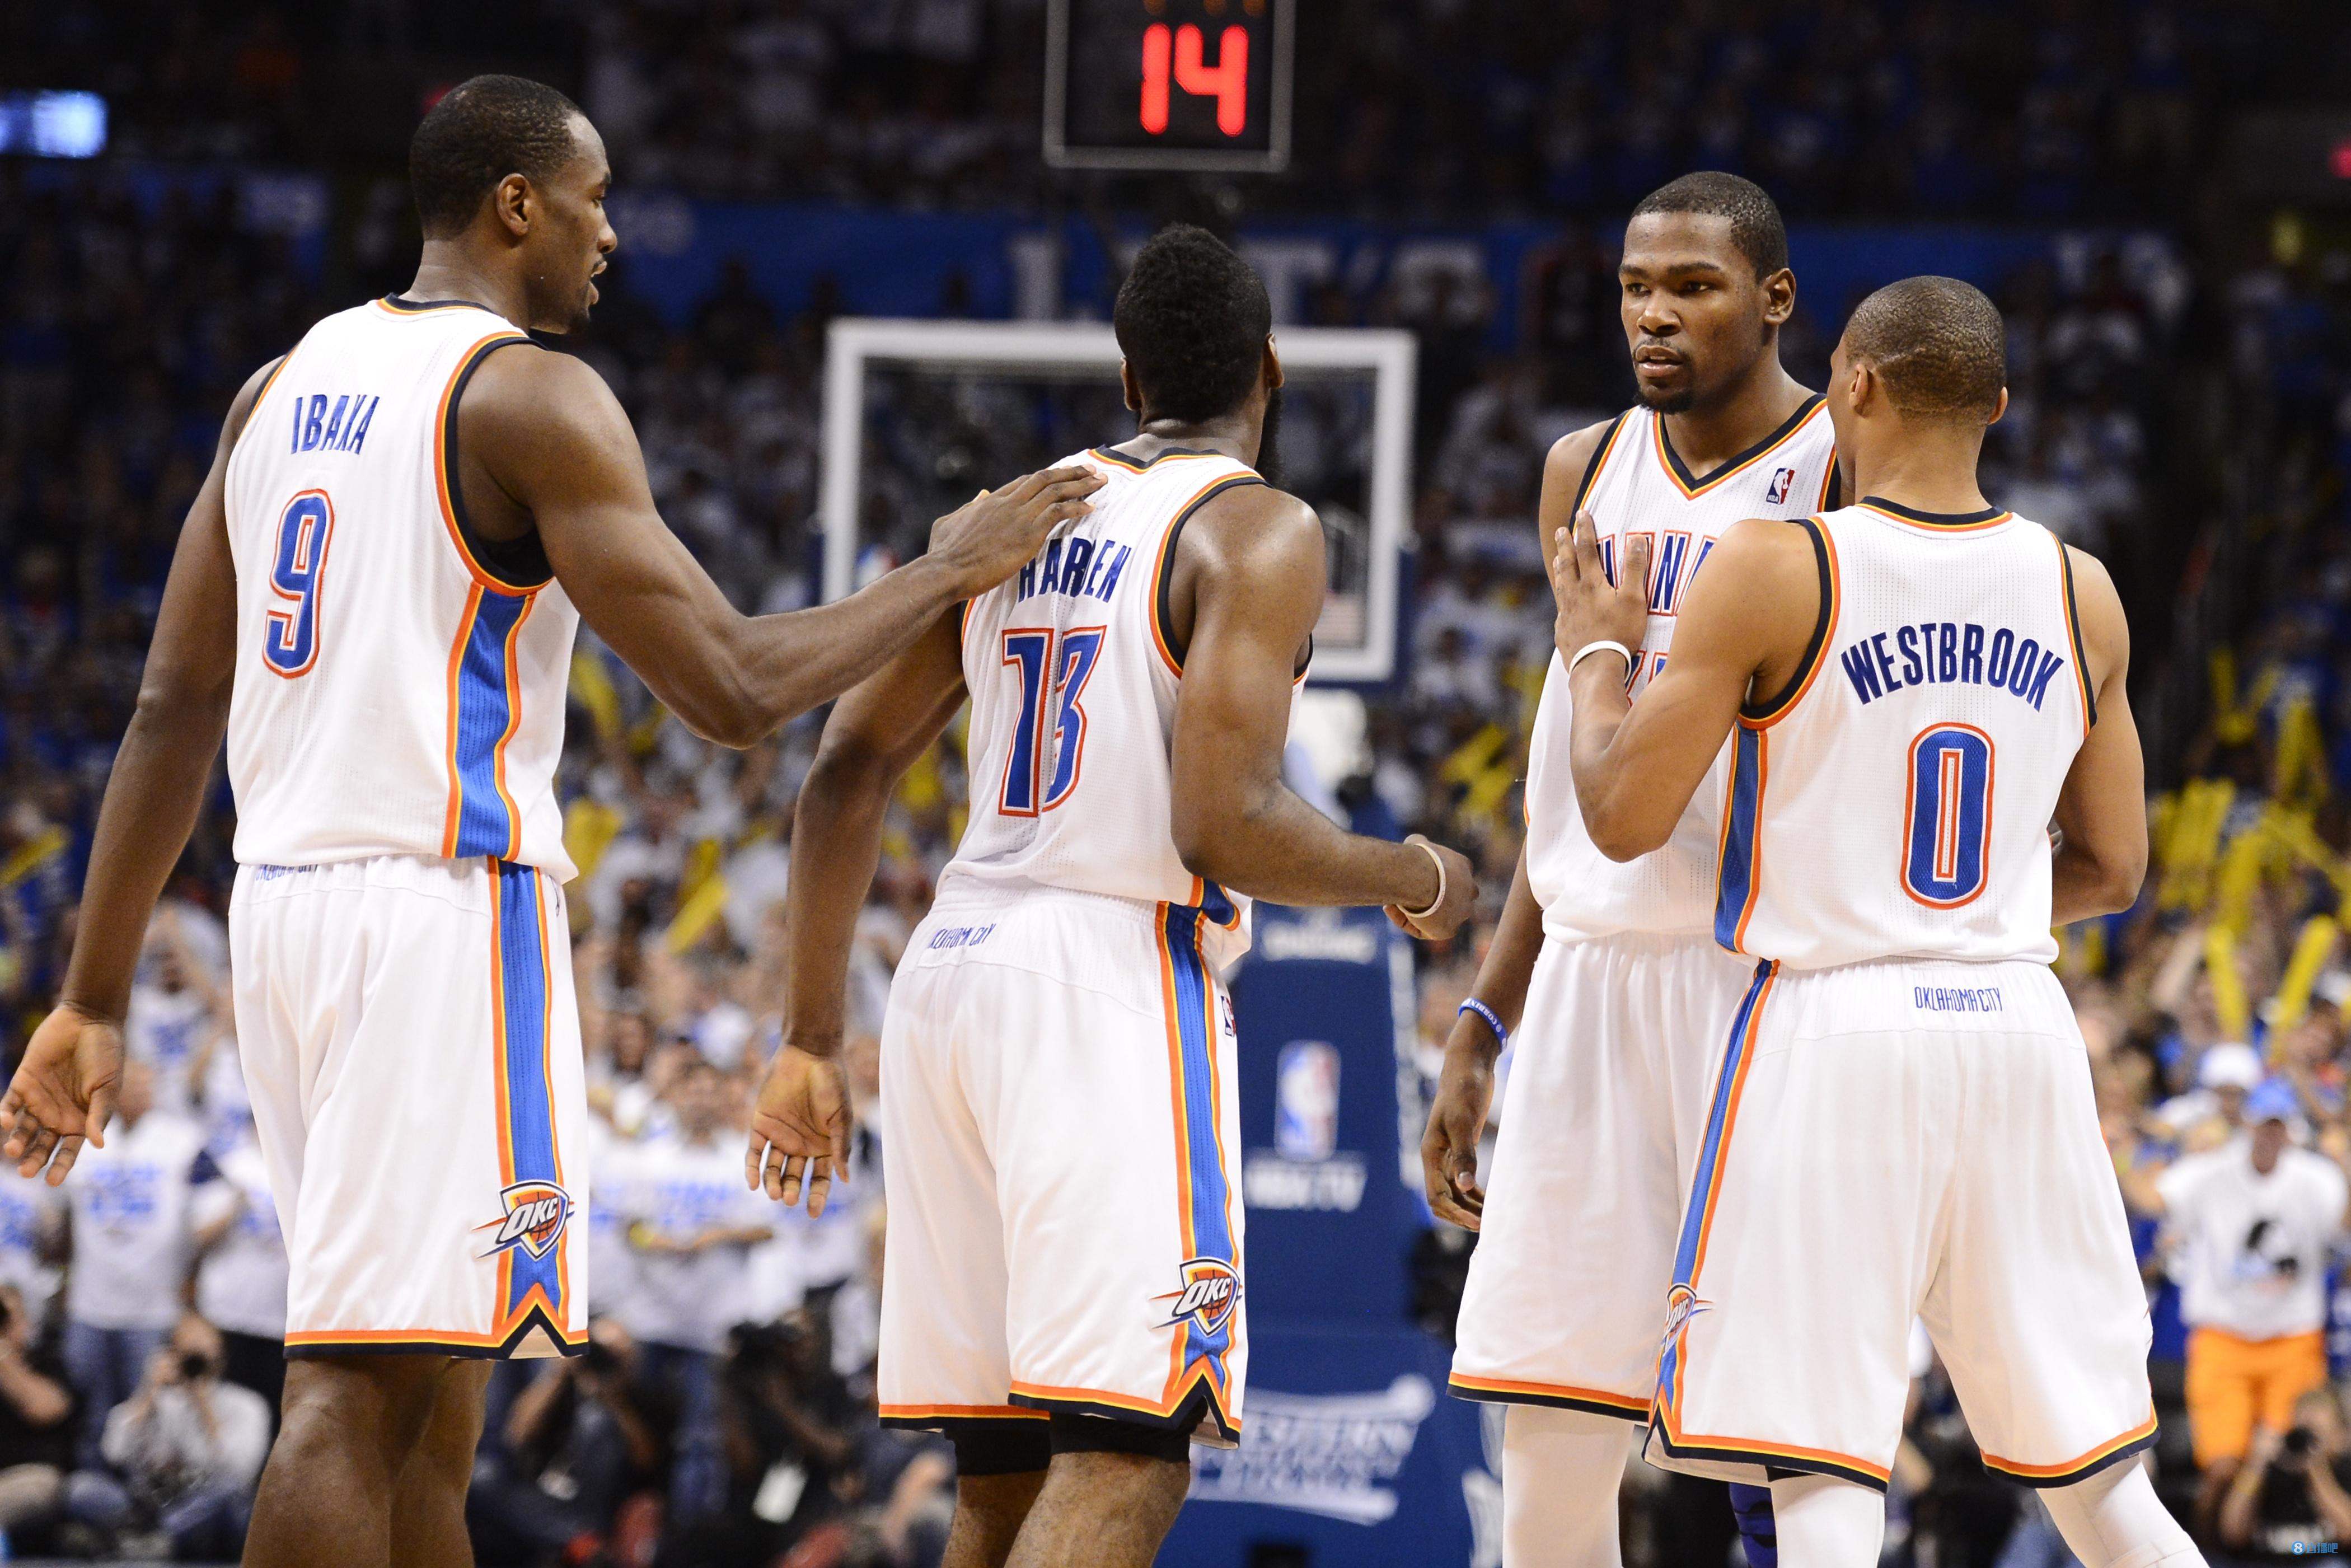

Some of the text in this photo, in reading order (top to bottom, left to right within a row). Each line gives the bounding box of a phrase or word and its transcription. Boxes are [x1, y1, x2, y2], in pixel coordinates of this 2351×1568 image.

[1140, 22, 1249, 137] 14
[291, 394, 380, 455] IBAKA
[262, 488, 334, 680] 9
[1840, 622, 2064, 713] WESTBROOK
[998, 625, 1107, 818] 13
[1899, 721, 1995, 910] 0
[1914, 986, 2003, 1012] OKLAHOMA CITY
[497, 1197, 559, 1243] OKC
[1174, 1276, 1232, 1316] OKC
